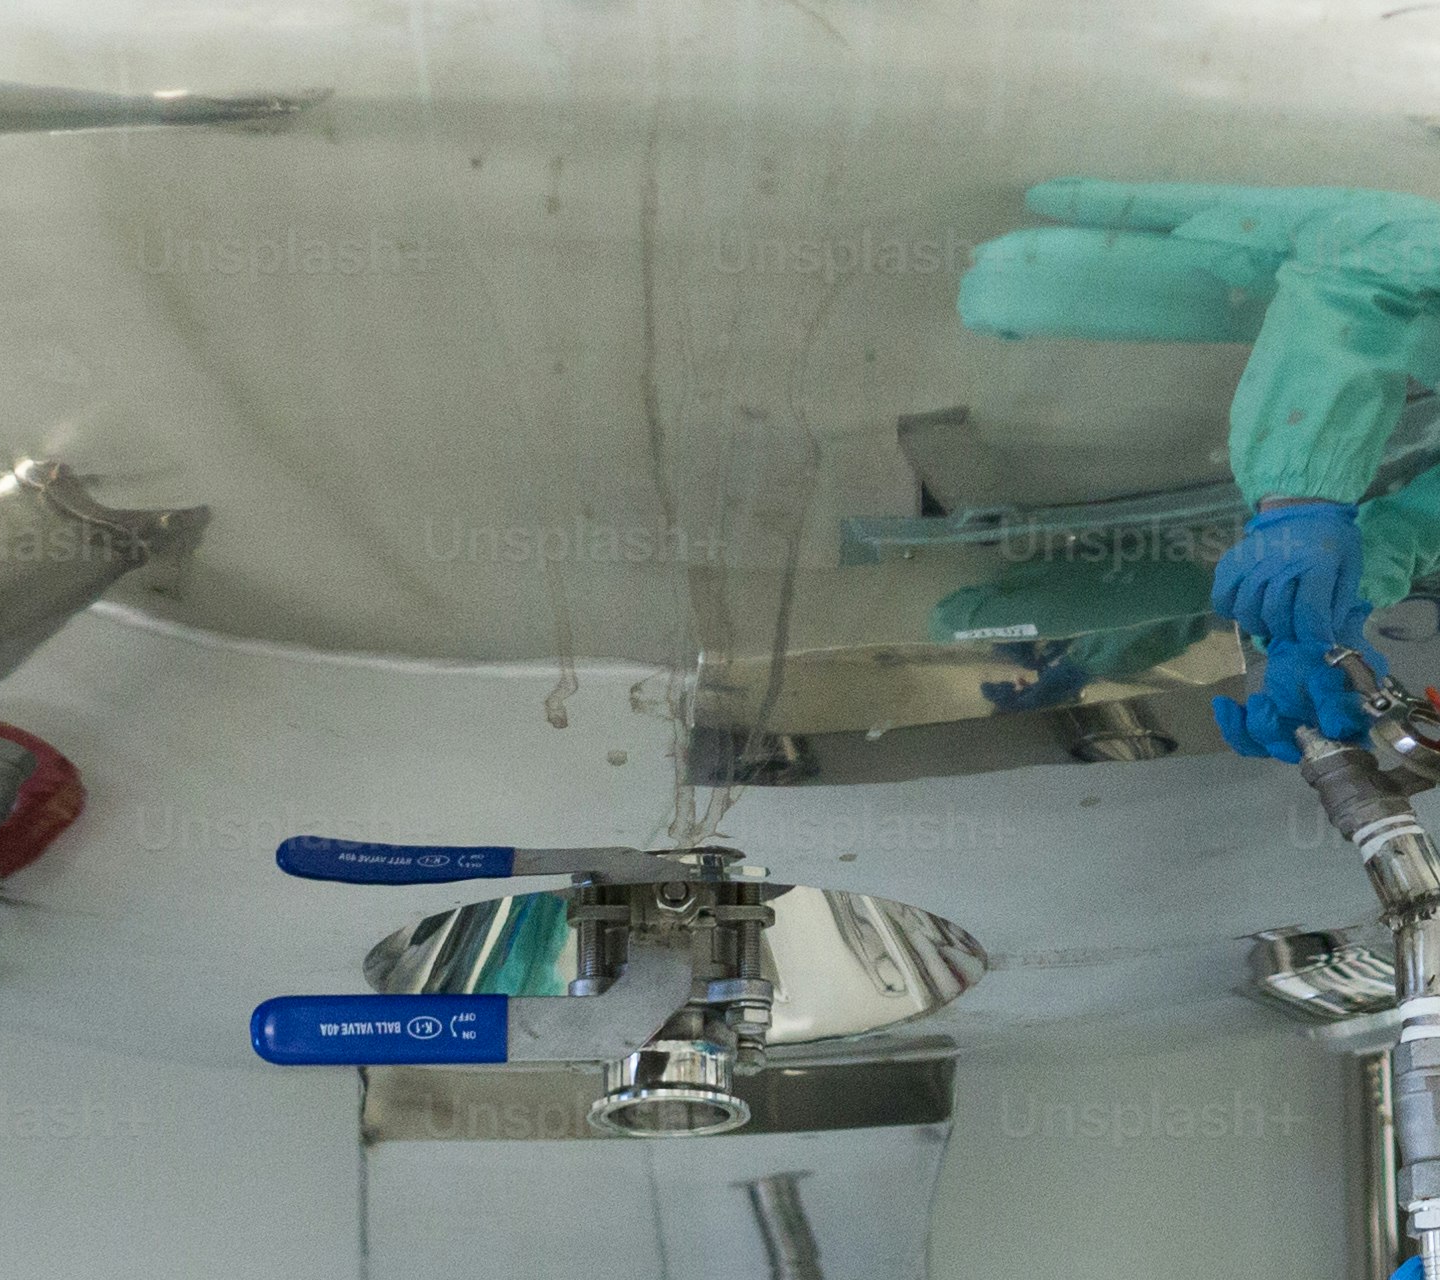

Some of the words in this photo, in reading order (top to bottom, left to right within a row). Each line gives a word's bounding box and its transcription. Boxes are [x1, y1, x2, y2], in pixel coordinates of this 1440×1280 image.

[458, 1013, 476, 1022] OFF
[320, 1023, 339, 1036] 40A
[341, 1022, 374, 1036] VALVE
[375, 1021, 401, 1035] BALL
[462, 1030, 477, 1039] ON
